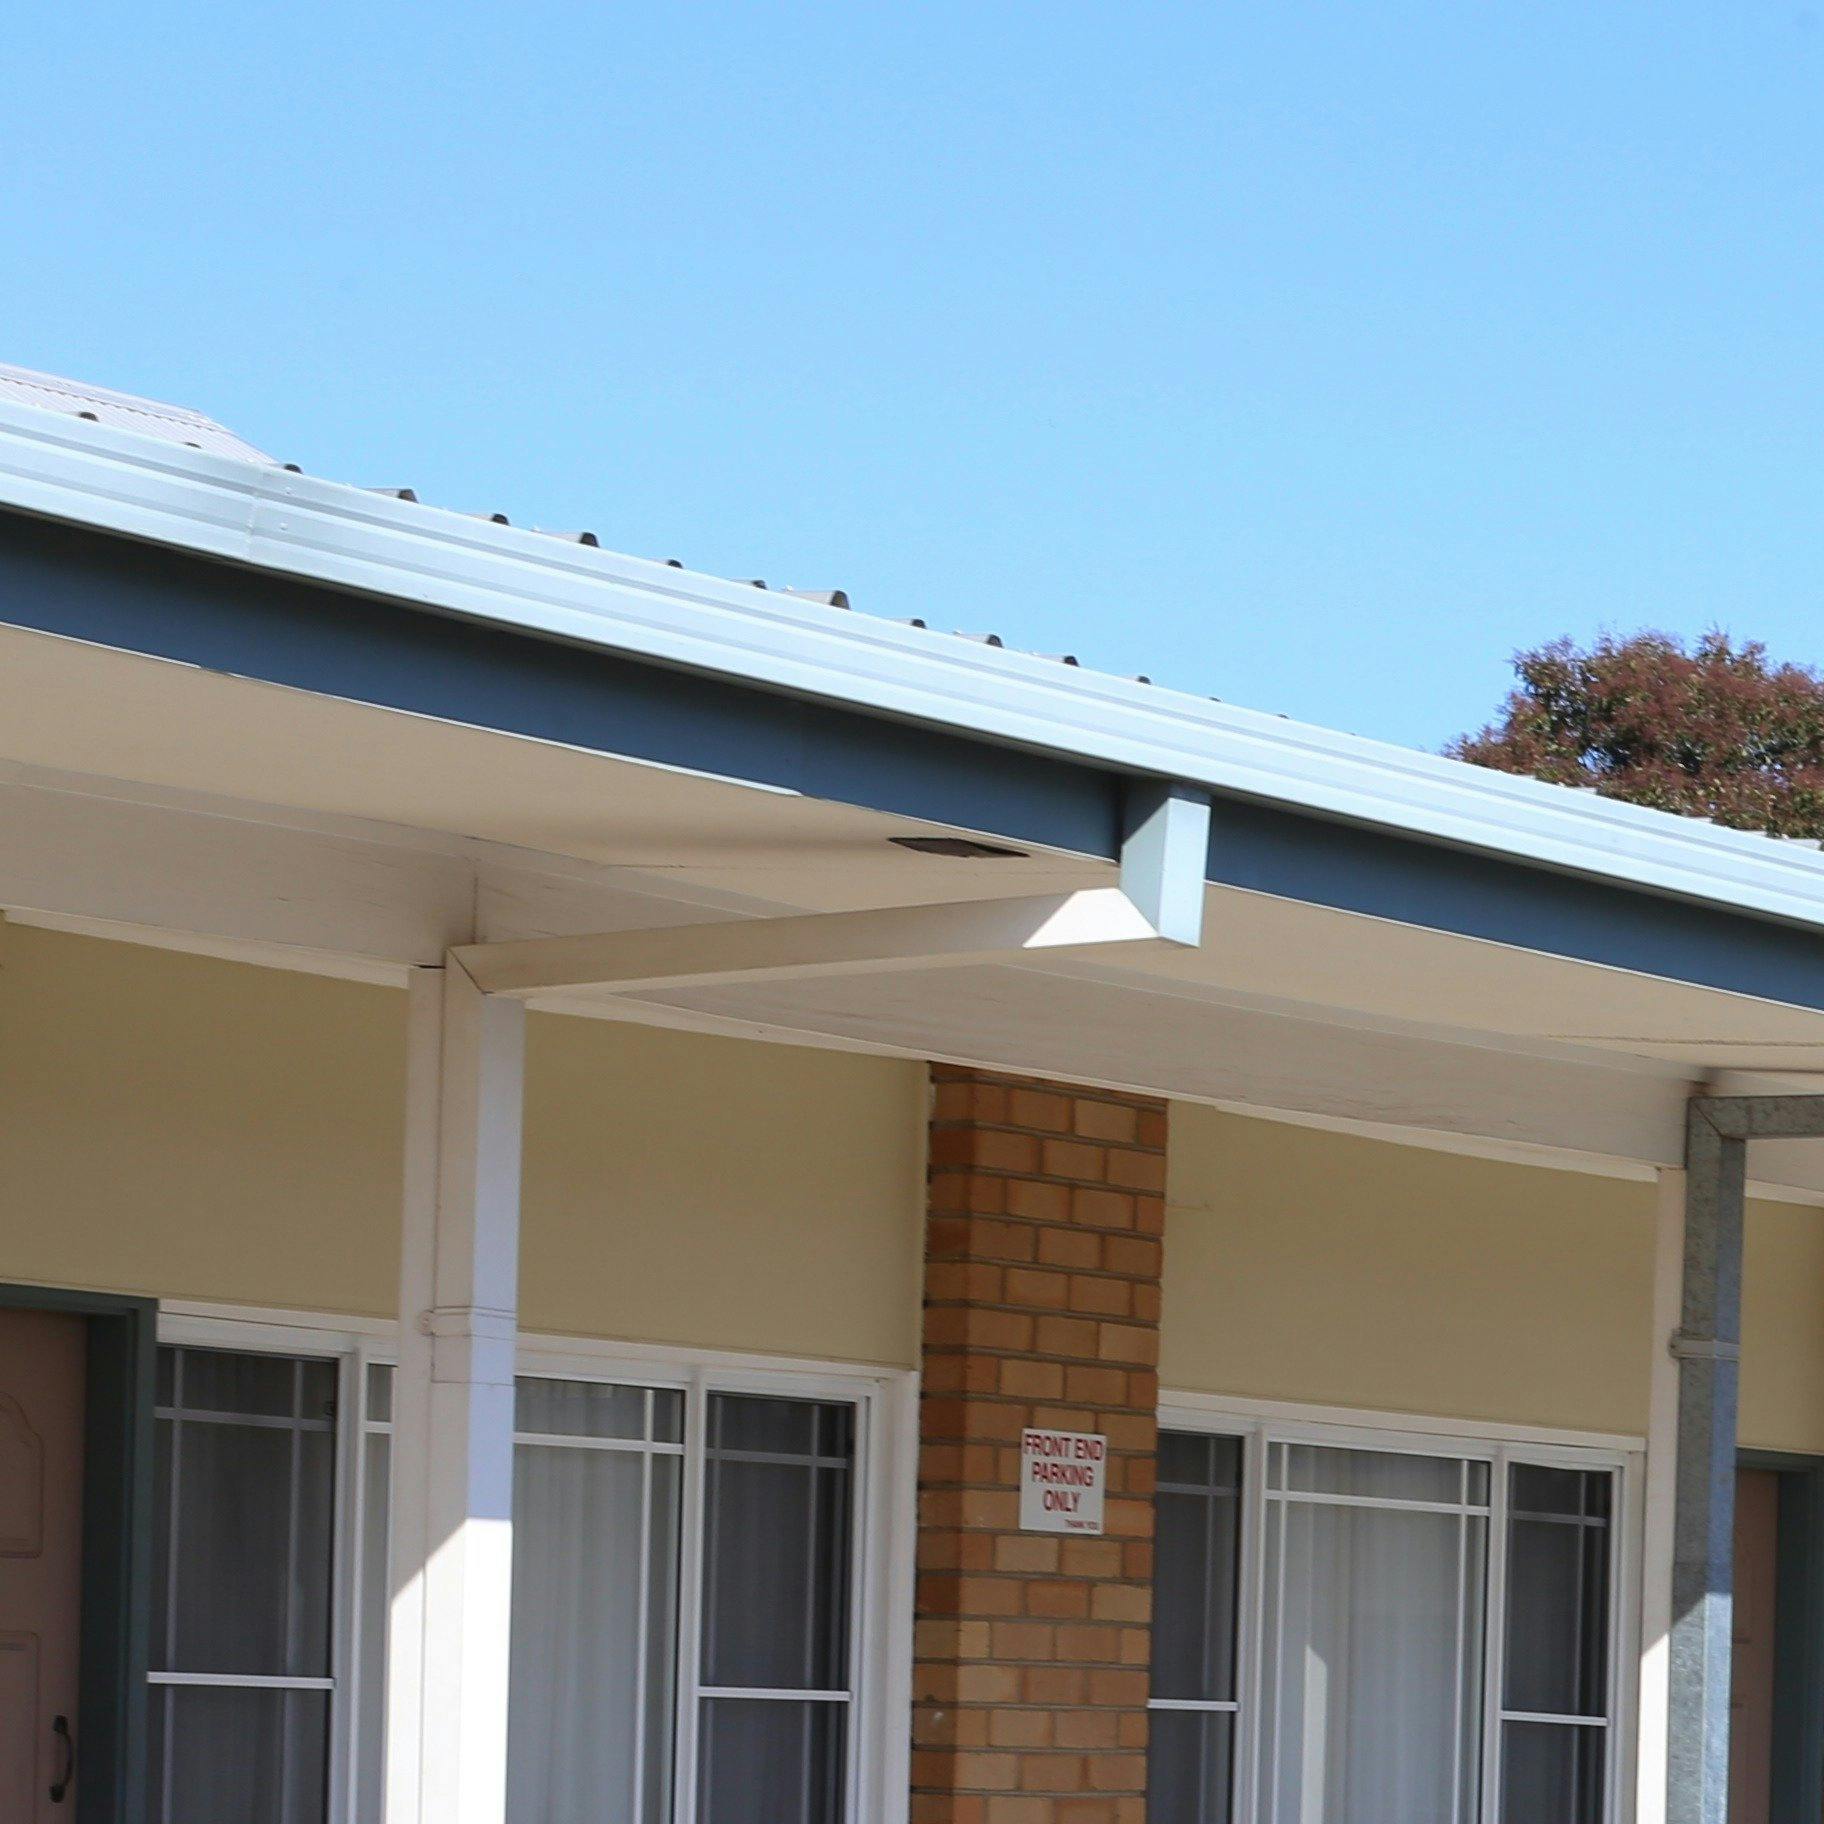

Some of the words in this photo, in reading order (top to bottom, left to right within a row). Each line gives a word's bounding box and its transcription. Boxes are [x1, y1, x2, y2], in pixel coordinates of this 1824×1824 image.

[1025, 1434, 1072, 1458] FRONT
[1075, 1438, 1103, 1461] END
[1032, 1461, 1095, 1487] PARKING
[1044, 1489, 1081, 1513] ONLY
